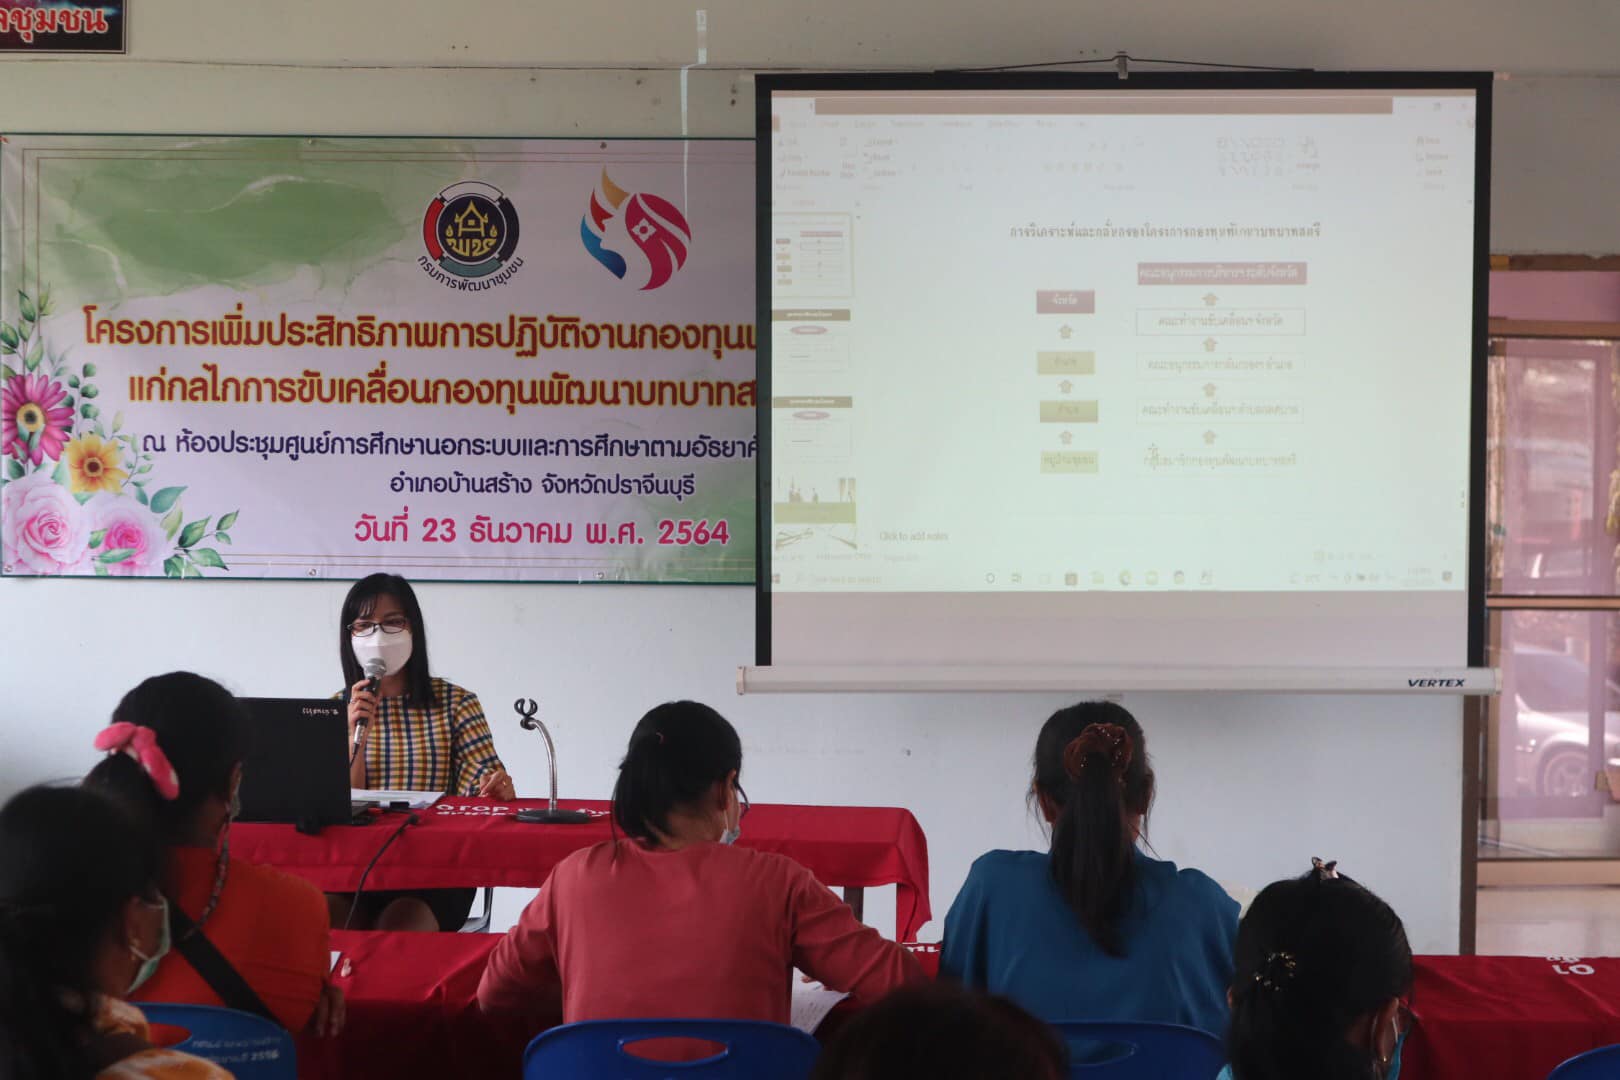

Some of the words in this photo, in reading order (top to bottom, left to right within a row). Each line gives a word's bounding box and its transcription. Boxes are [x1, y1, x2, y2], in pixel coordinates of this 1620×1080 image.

[417, 255, 525, 292] กรมการพัฒนาชุมชน
[143, 434, 166, 452] ณ
[390, 470, 532, 495] อำเภอบ้านสร้าง
[541, 472, 696, 501] จังหวัดปราจีนบุรี
[354, 505, 409, 543] วันที่
[421, 517, 457, 543] 23
[469, 515, 573, 544] ธันวาคม
[586, 520, 644, 545] พ.ศ.
[657, 519, 730, 545] 2564
[1408, 678, 1465, 688] VERTEX
